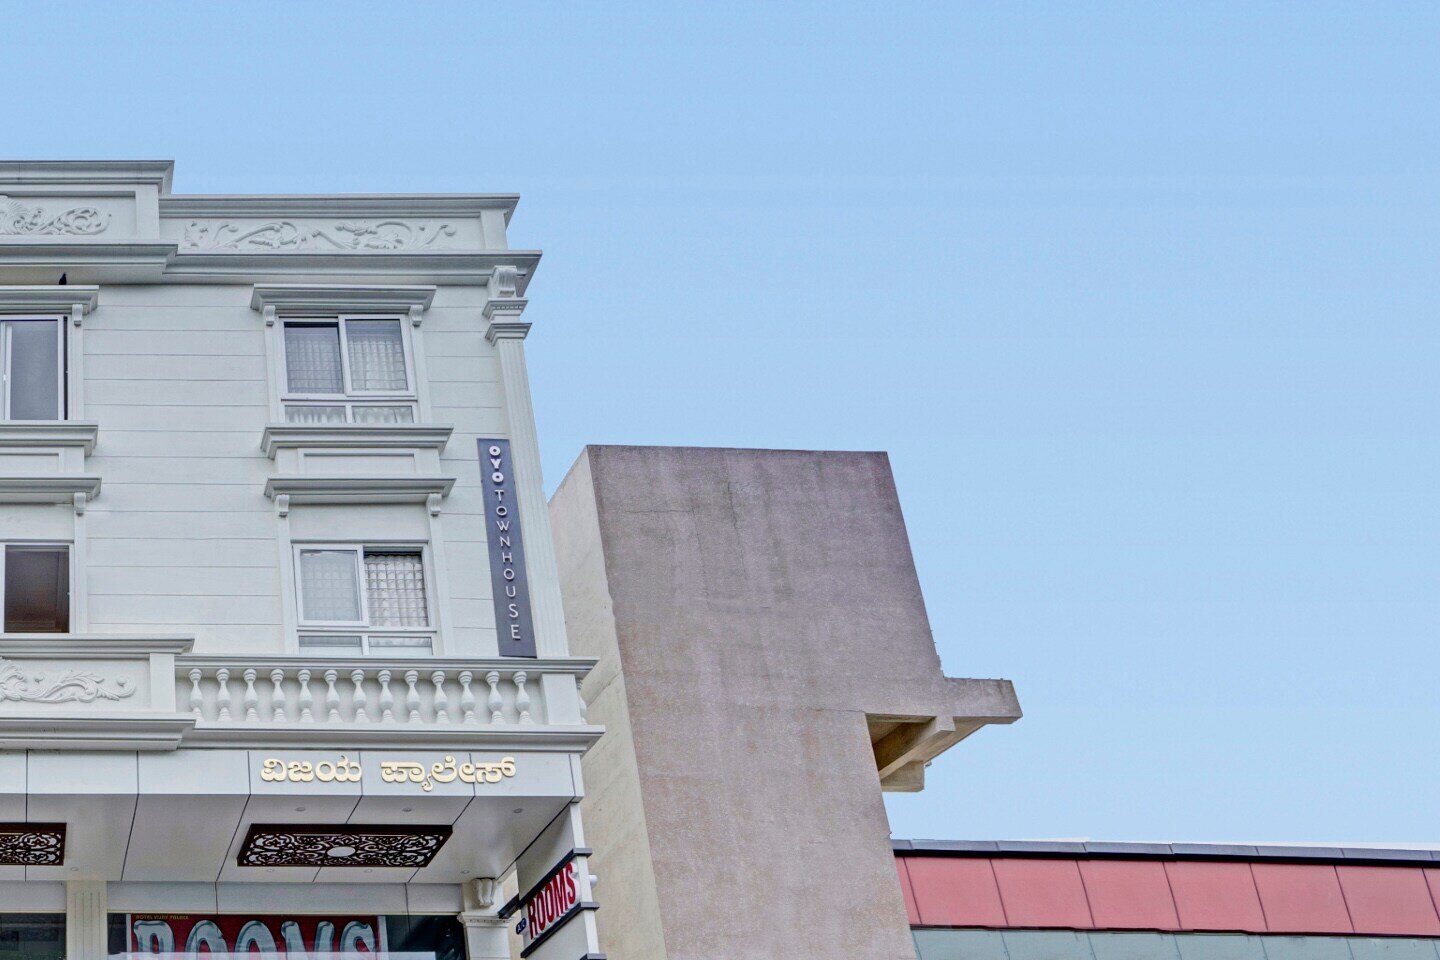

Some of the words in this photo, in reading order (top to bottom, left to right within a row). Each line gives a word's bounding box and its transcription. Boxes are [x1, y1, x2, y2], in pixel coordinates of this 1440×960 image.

[489, 446, 504, 484] OYO
[495, 489, 521, 640] TOWNHOUSE
[260, 755, 362, 782] ವಿಜಯ
[380, 756, 516, 792] ಪ್ಯಾಲೇಸ್
[526, 861, 577, 940] ROOMS
